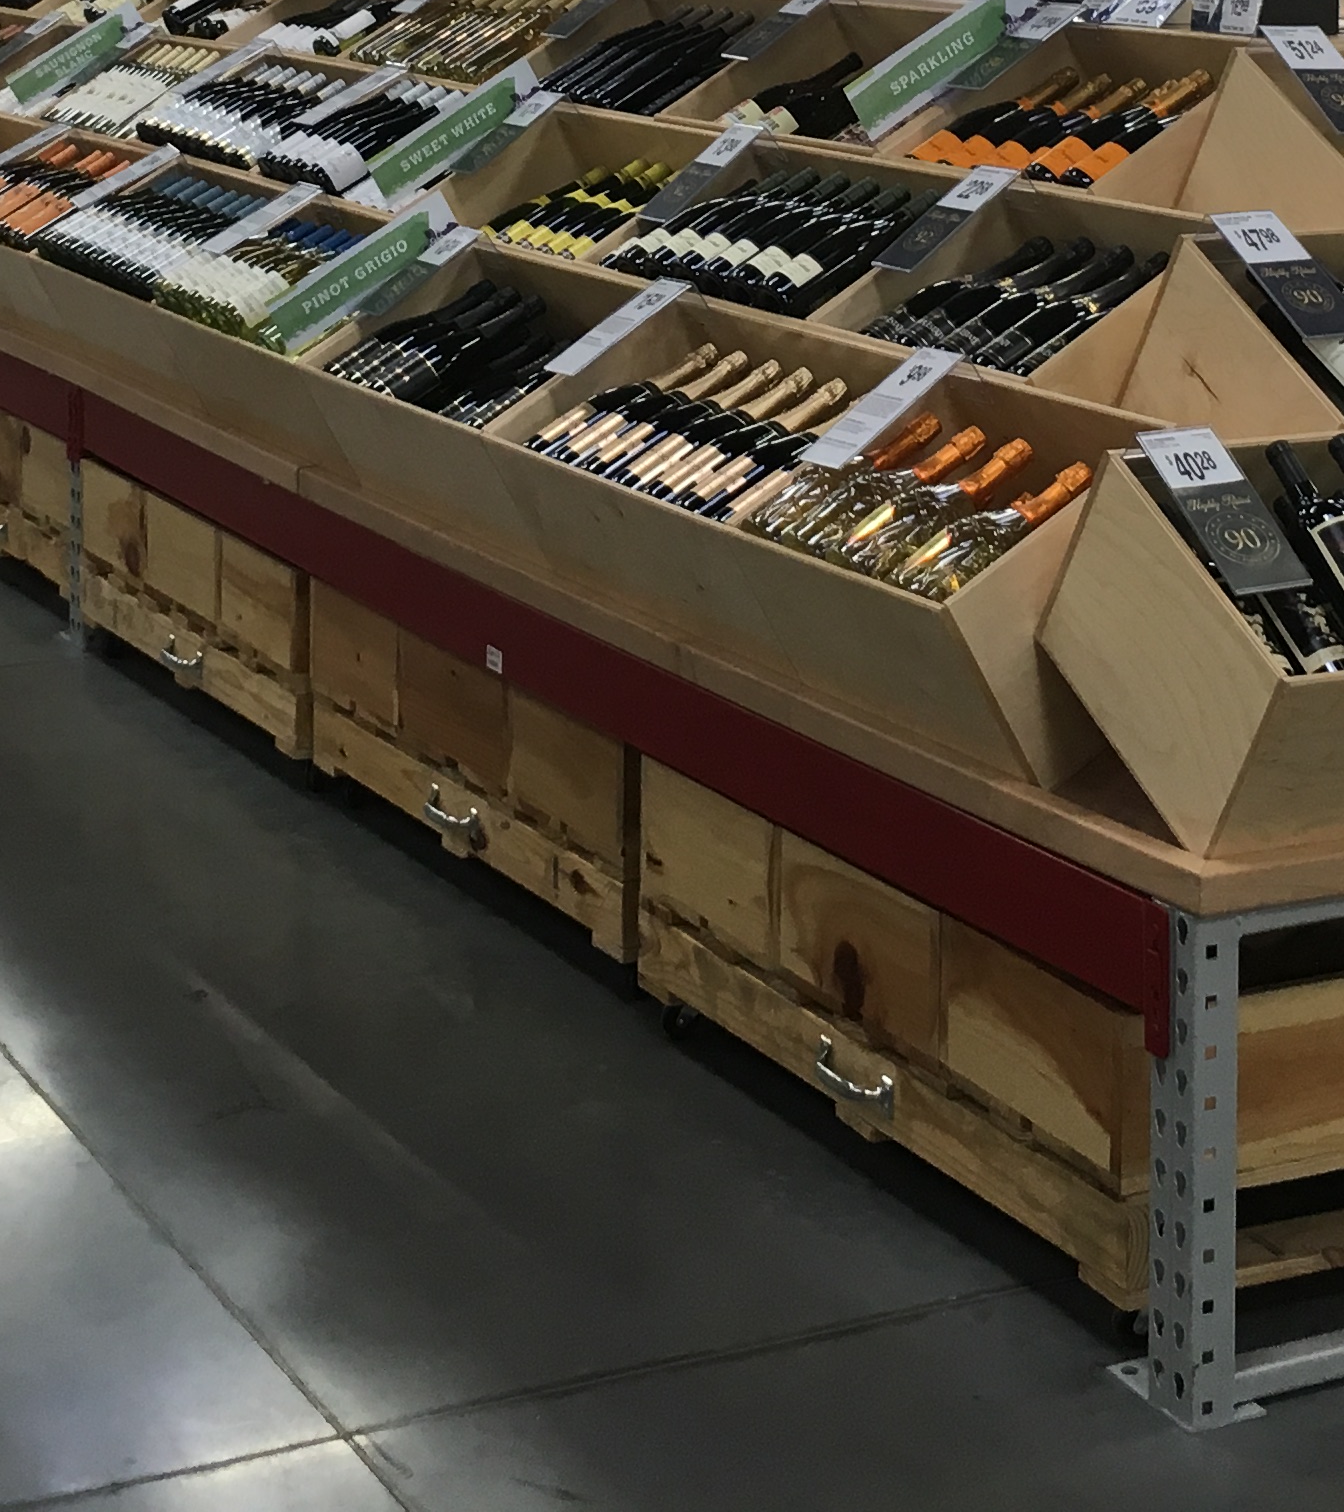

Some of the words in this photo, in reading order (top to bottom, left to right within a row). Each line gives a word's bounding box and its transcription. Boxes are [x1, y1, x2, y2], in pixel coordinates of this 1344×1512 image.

[34, 32, 102, 78] SAUVIGNON
[55, 49, 93, 78] BLANC
[889, 30, 976, 96] SPARKLING
[399, 134, 450, 172] SWEET
[451, 102, 497, 140] WHITE
[301, 276, 350, 315] PINOT
[354, 239, 408, 281] GRIGIO
[1292, 289, 1323, 304] 90
[1224, 527, 1261, 551] 90
